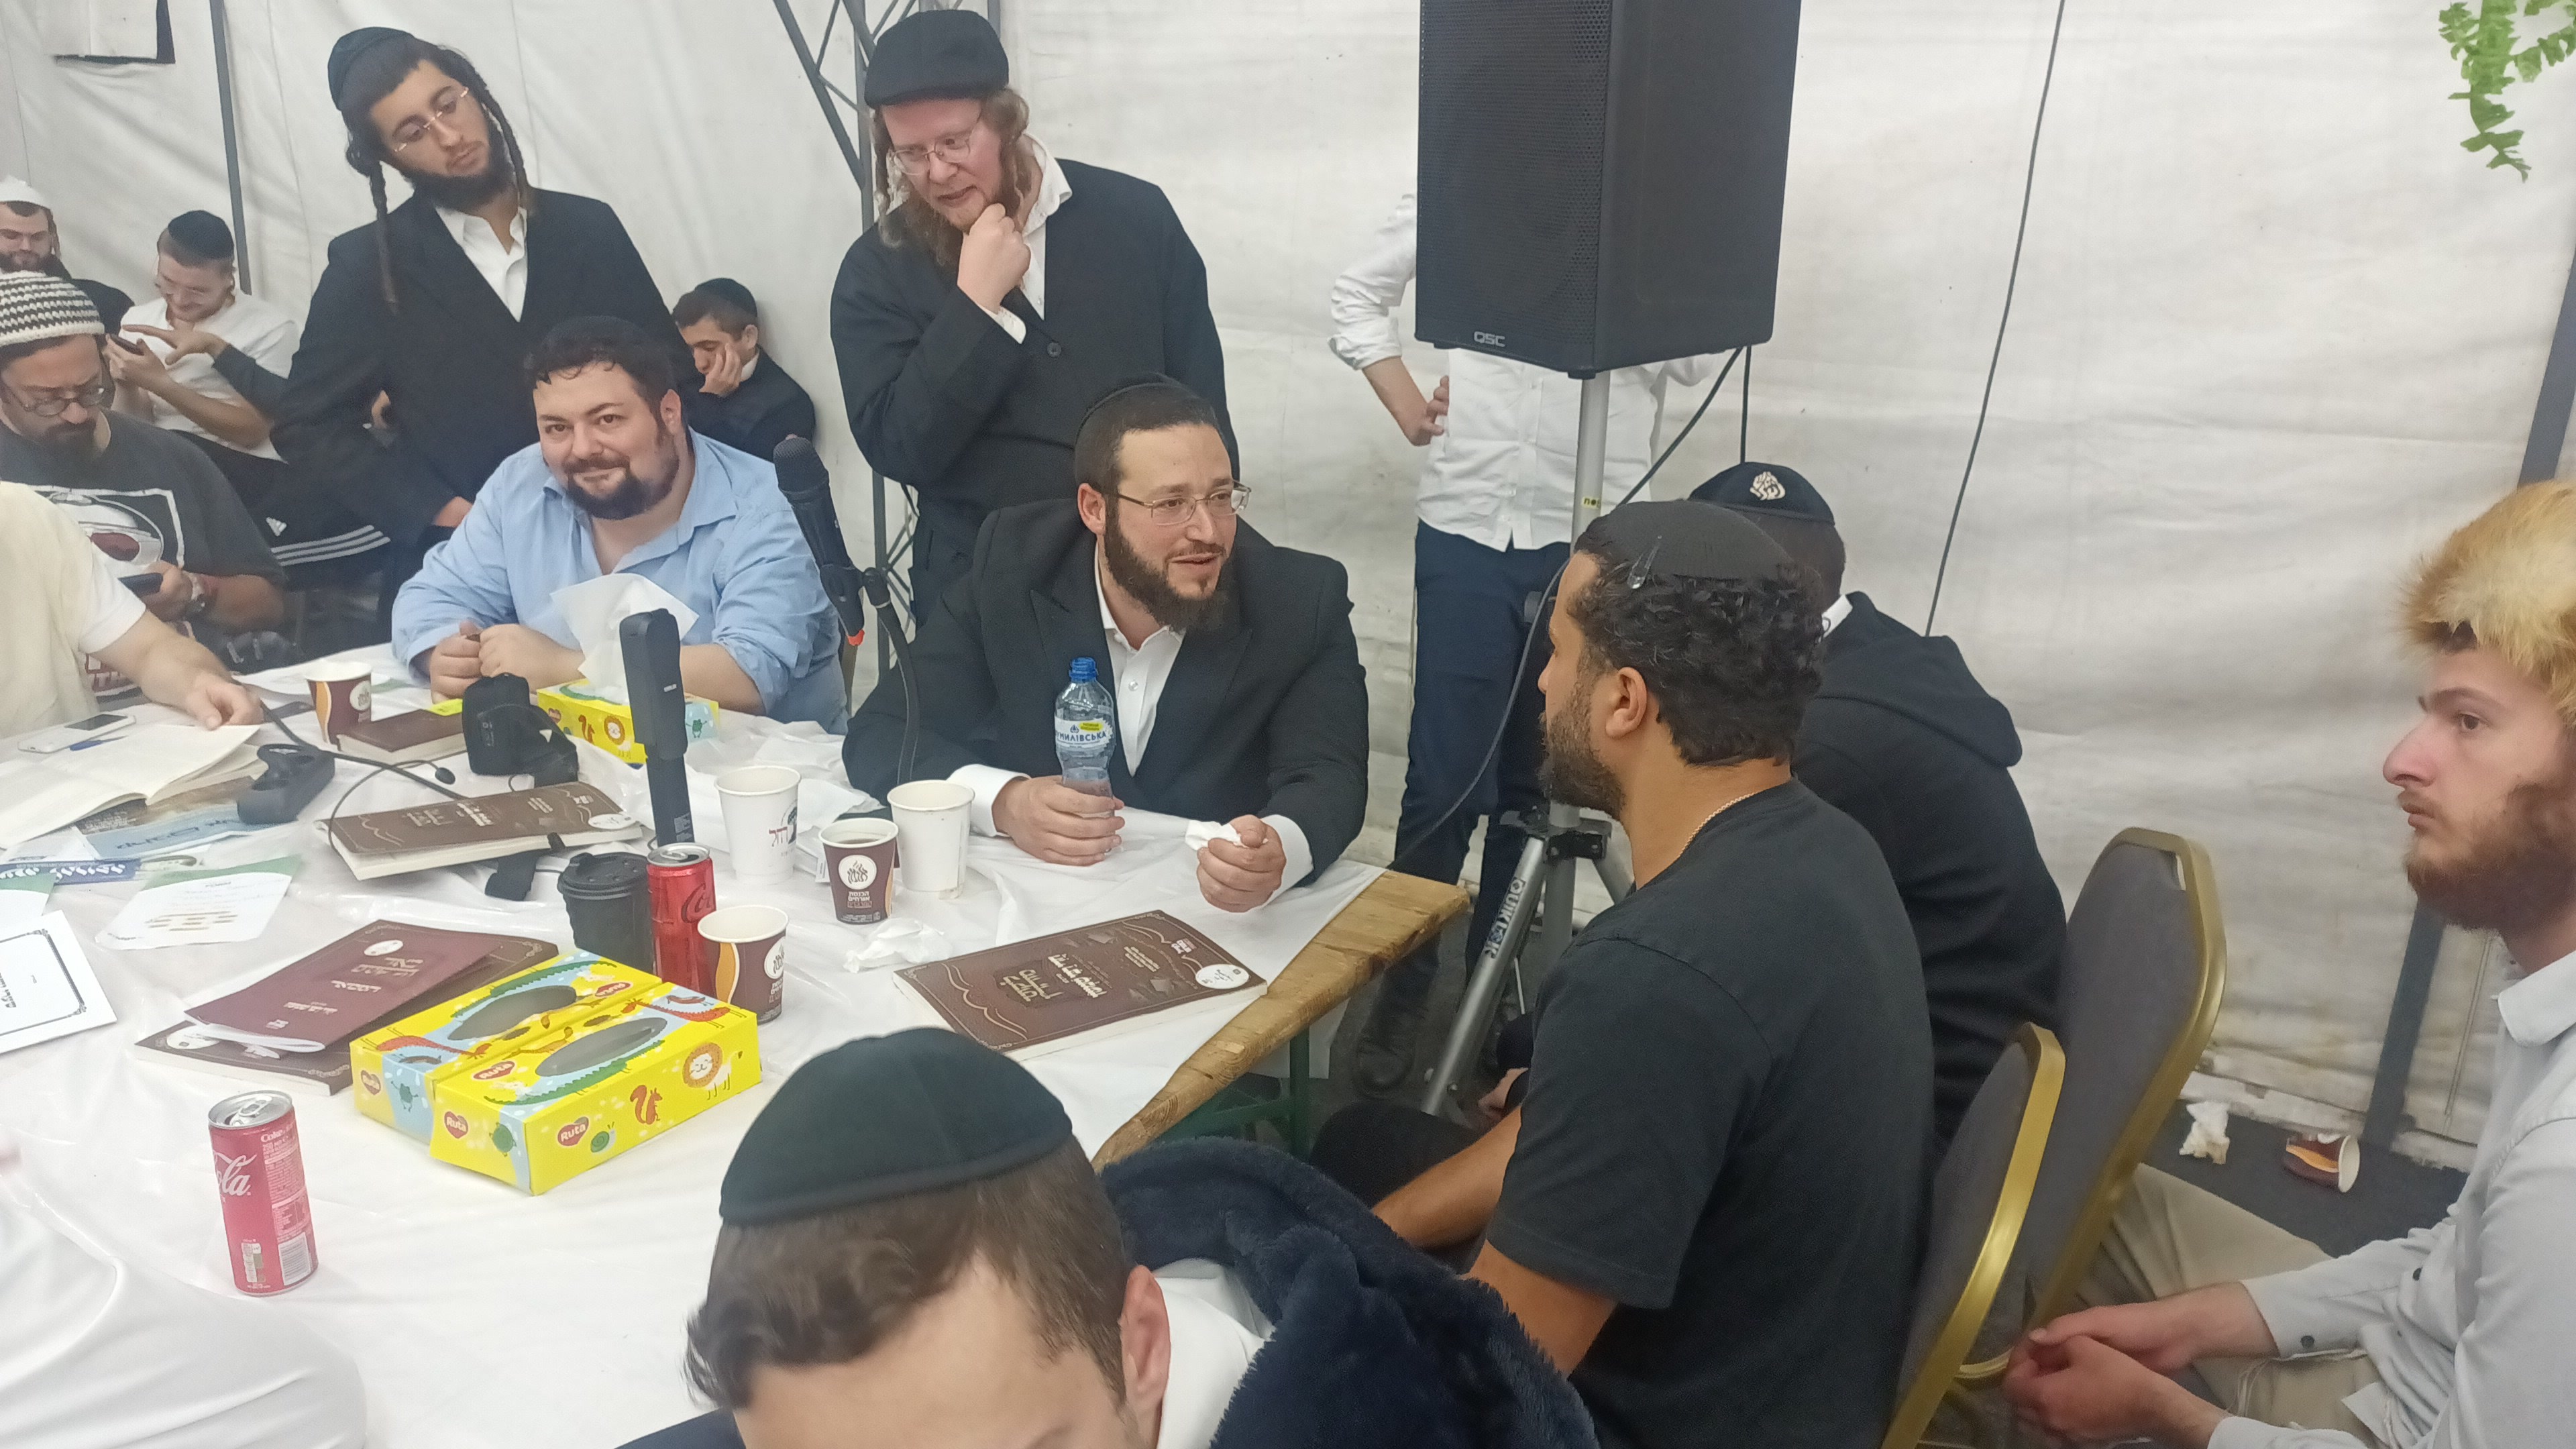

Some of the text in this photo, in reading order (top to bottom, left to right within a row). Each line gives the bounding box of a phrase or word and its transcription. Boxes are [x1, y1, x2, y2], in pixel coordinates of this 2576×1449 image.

[1474, 331, 1505, 347] QSC
[446, 1116, 467, 1132] Ruta
[560, 1124, 586, 1142] Ruta
[213, 1150, 257, 1196] ola
